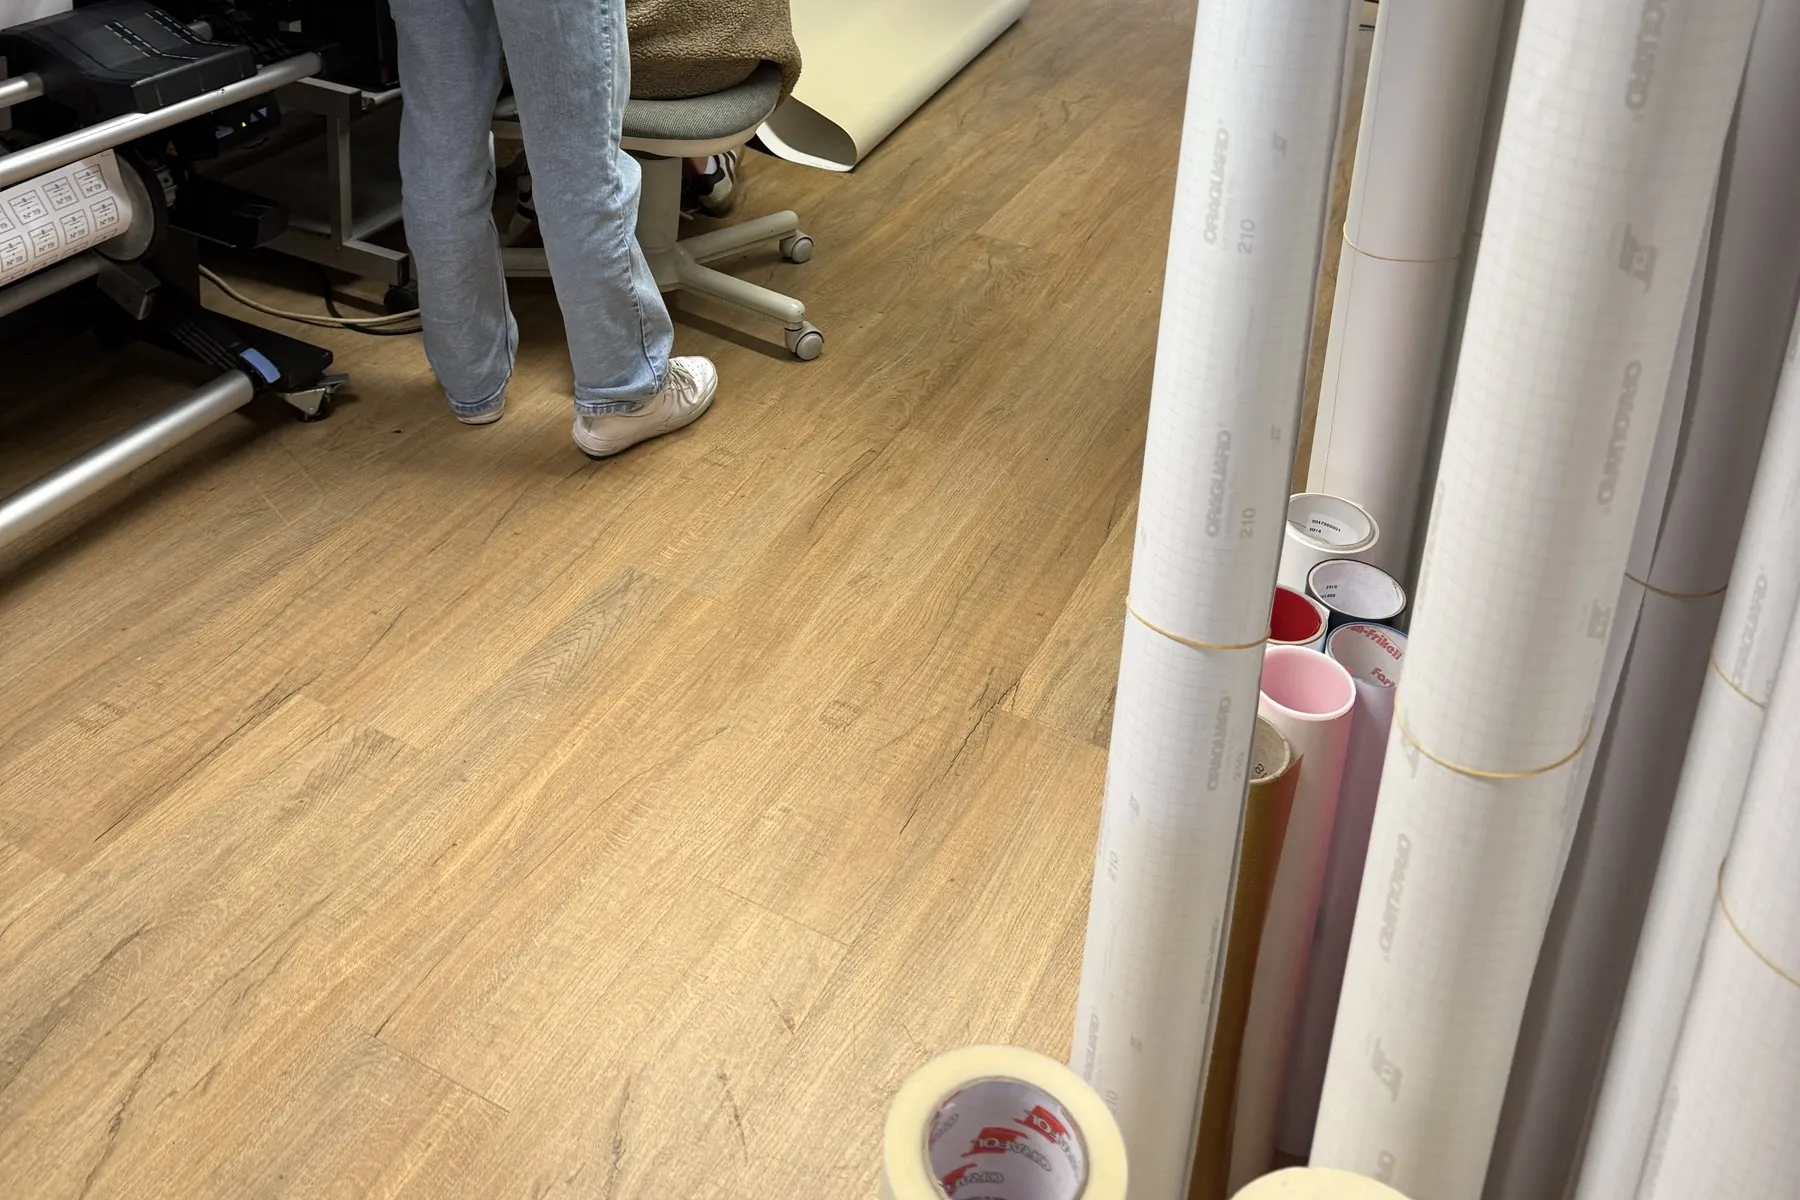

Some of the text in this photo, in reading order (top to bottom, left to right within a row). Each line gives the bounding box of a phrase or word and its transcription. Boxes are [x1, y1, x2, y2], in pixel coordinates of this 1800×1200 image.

[1203, 127, 1229, 246] ORAGUARD
[1237, 219, 1255, 255] 210
[1597, 360, 1644, 506] ORAGUARD
[1204, 430, 1232, 538] ORAGUARD
[1239, 508, 1257, 540] 210
[1107, 850, 1120, 883] 210
[1380, 832, 1413, 954] ORAGUARD
[970, 1137, 1052, 1173] ORAFOL
